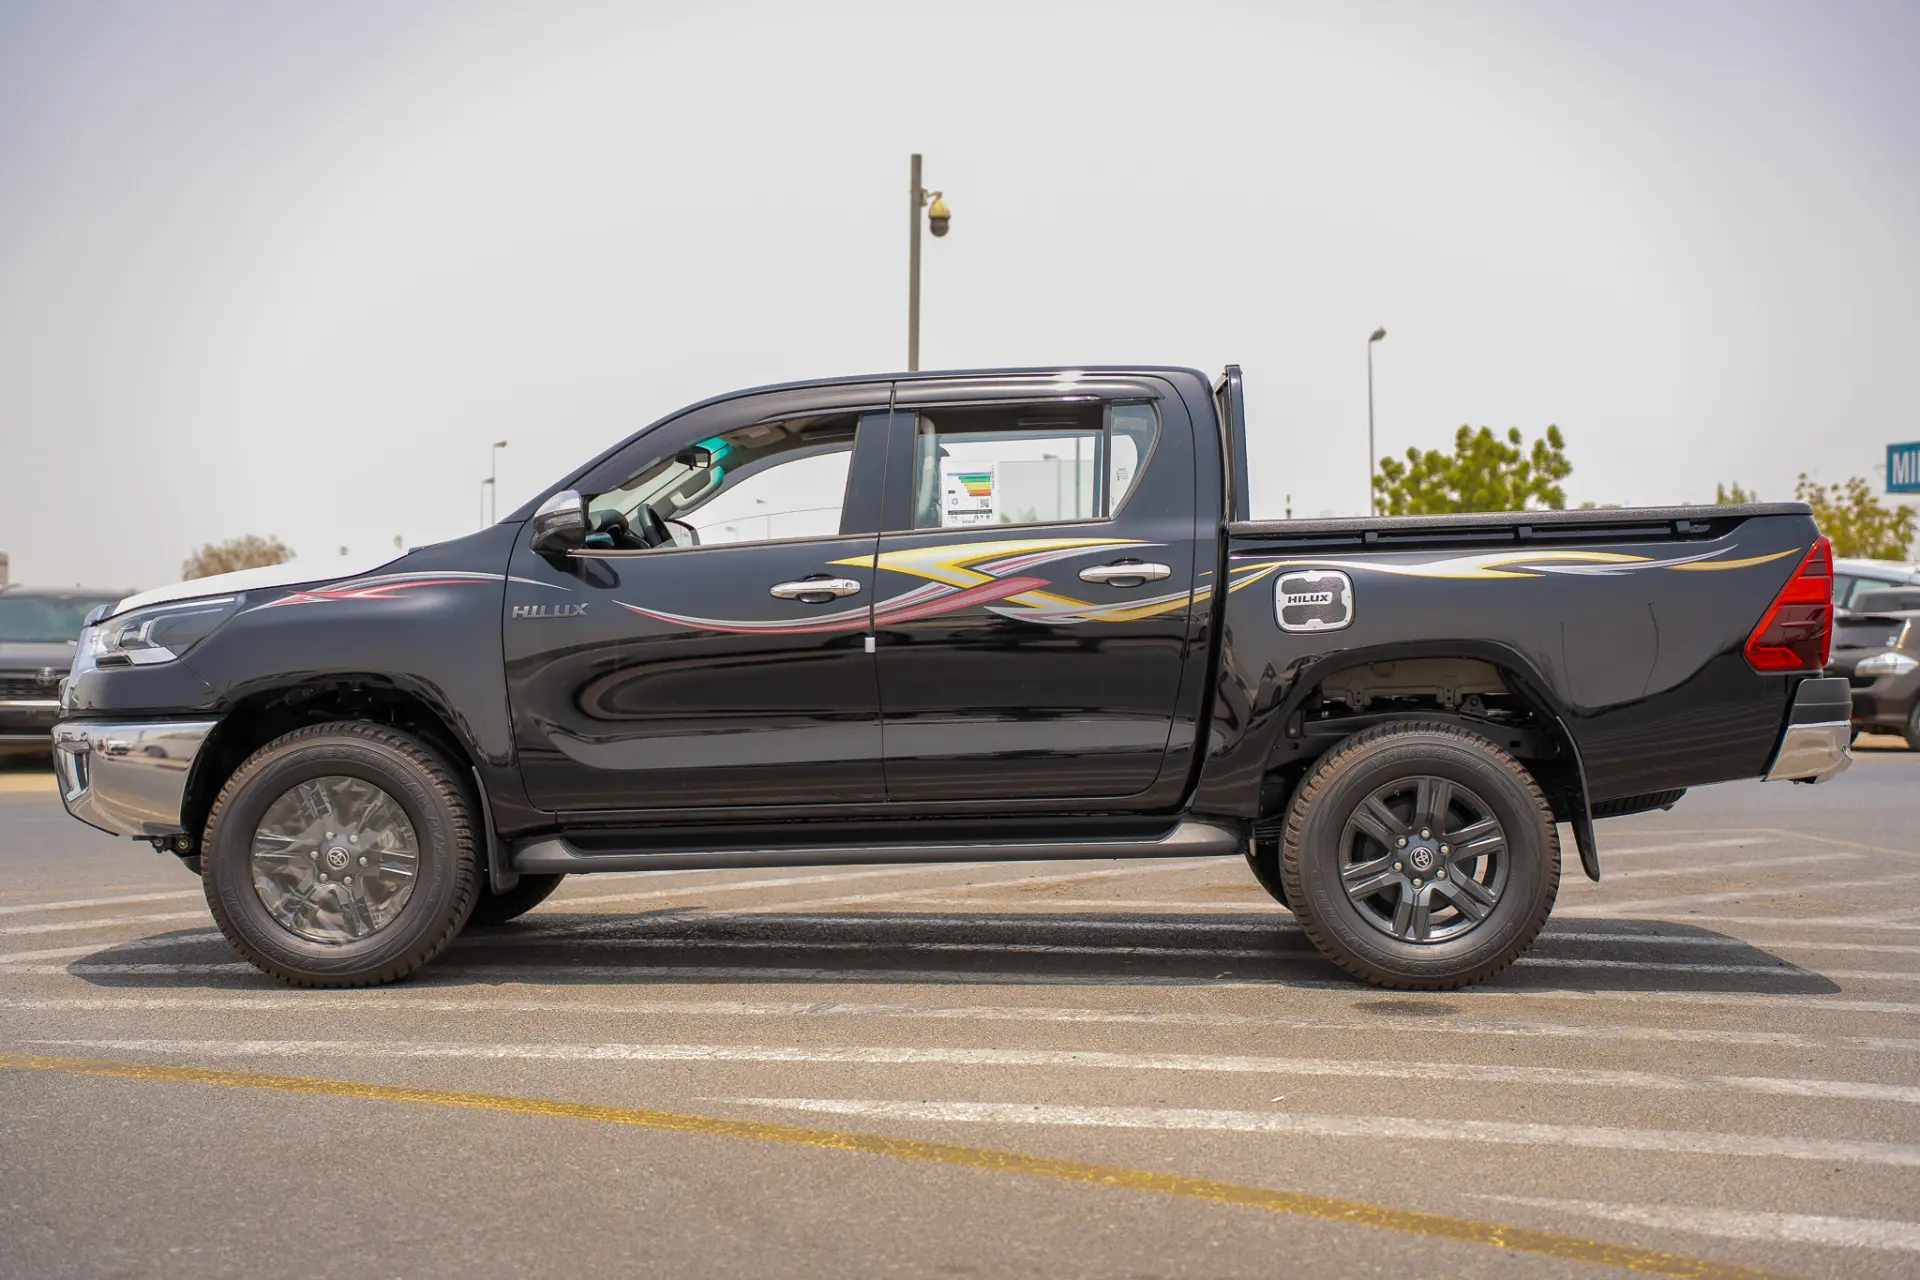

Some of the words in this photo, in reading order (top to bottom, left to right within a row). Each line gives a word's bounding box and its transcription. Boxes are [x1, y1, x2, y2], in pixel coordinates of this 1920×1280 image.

[1892, 450, 1920, 485] MI
[1287, 594, 1329, 604] HILUX
[511, 602, 589, 620] HILUX
